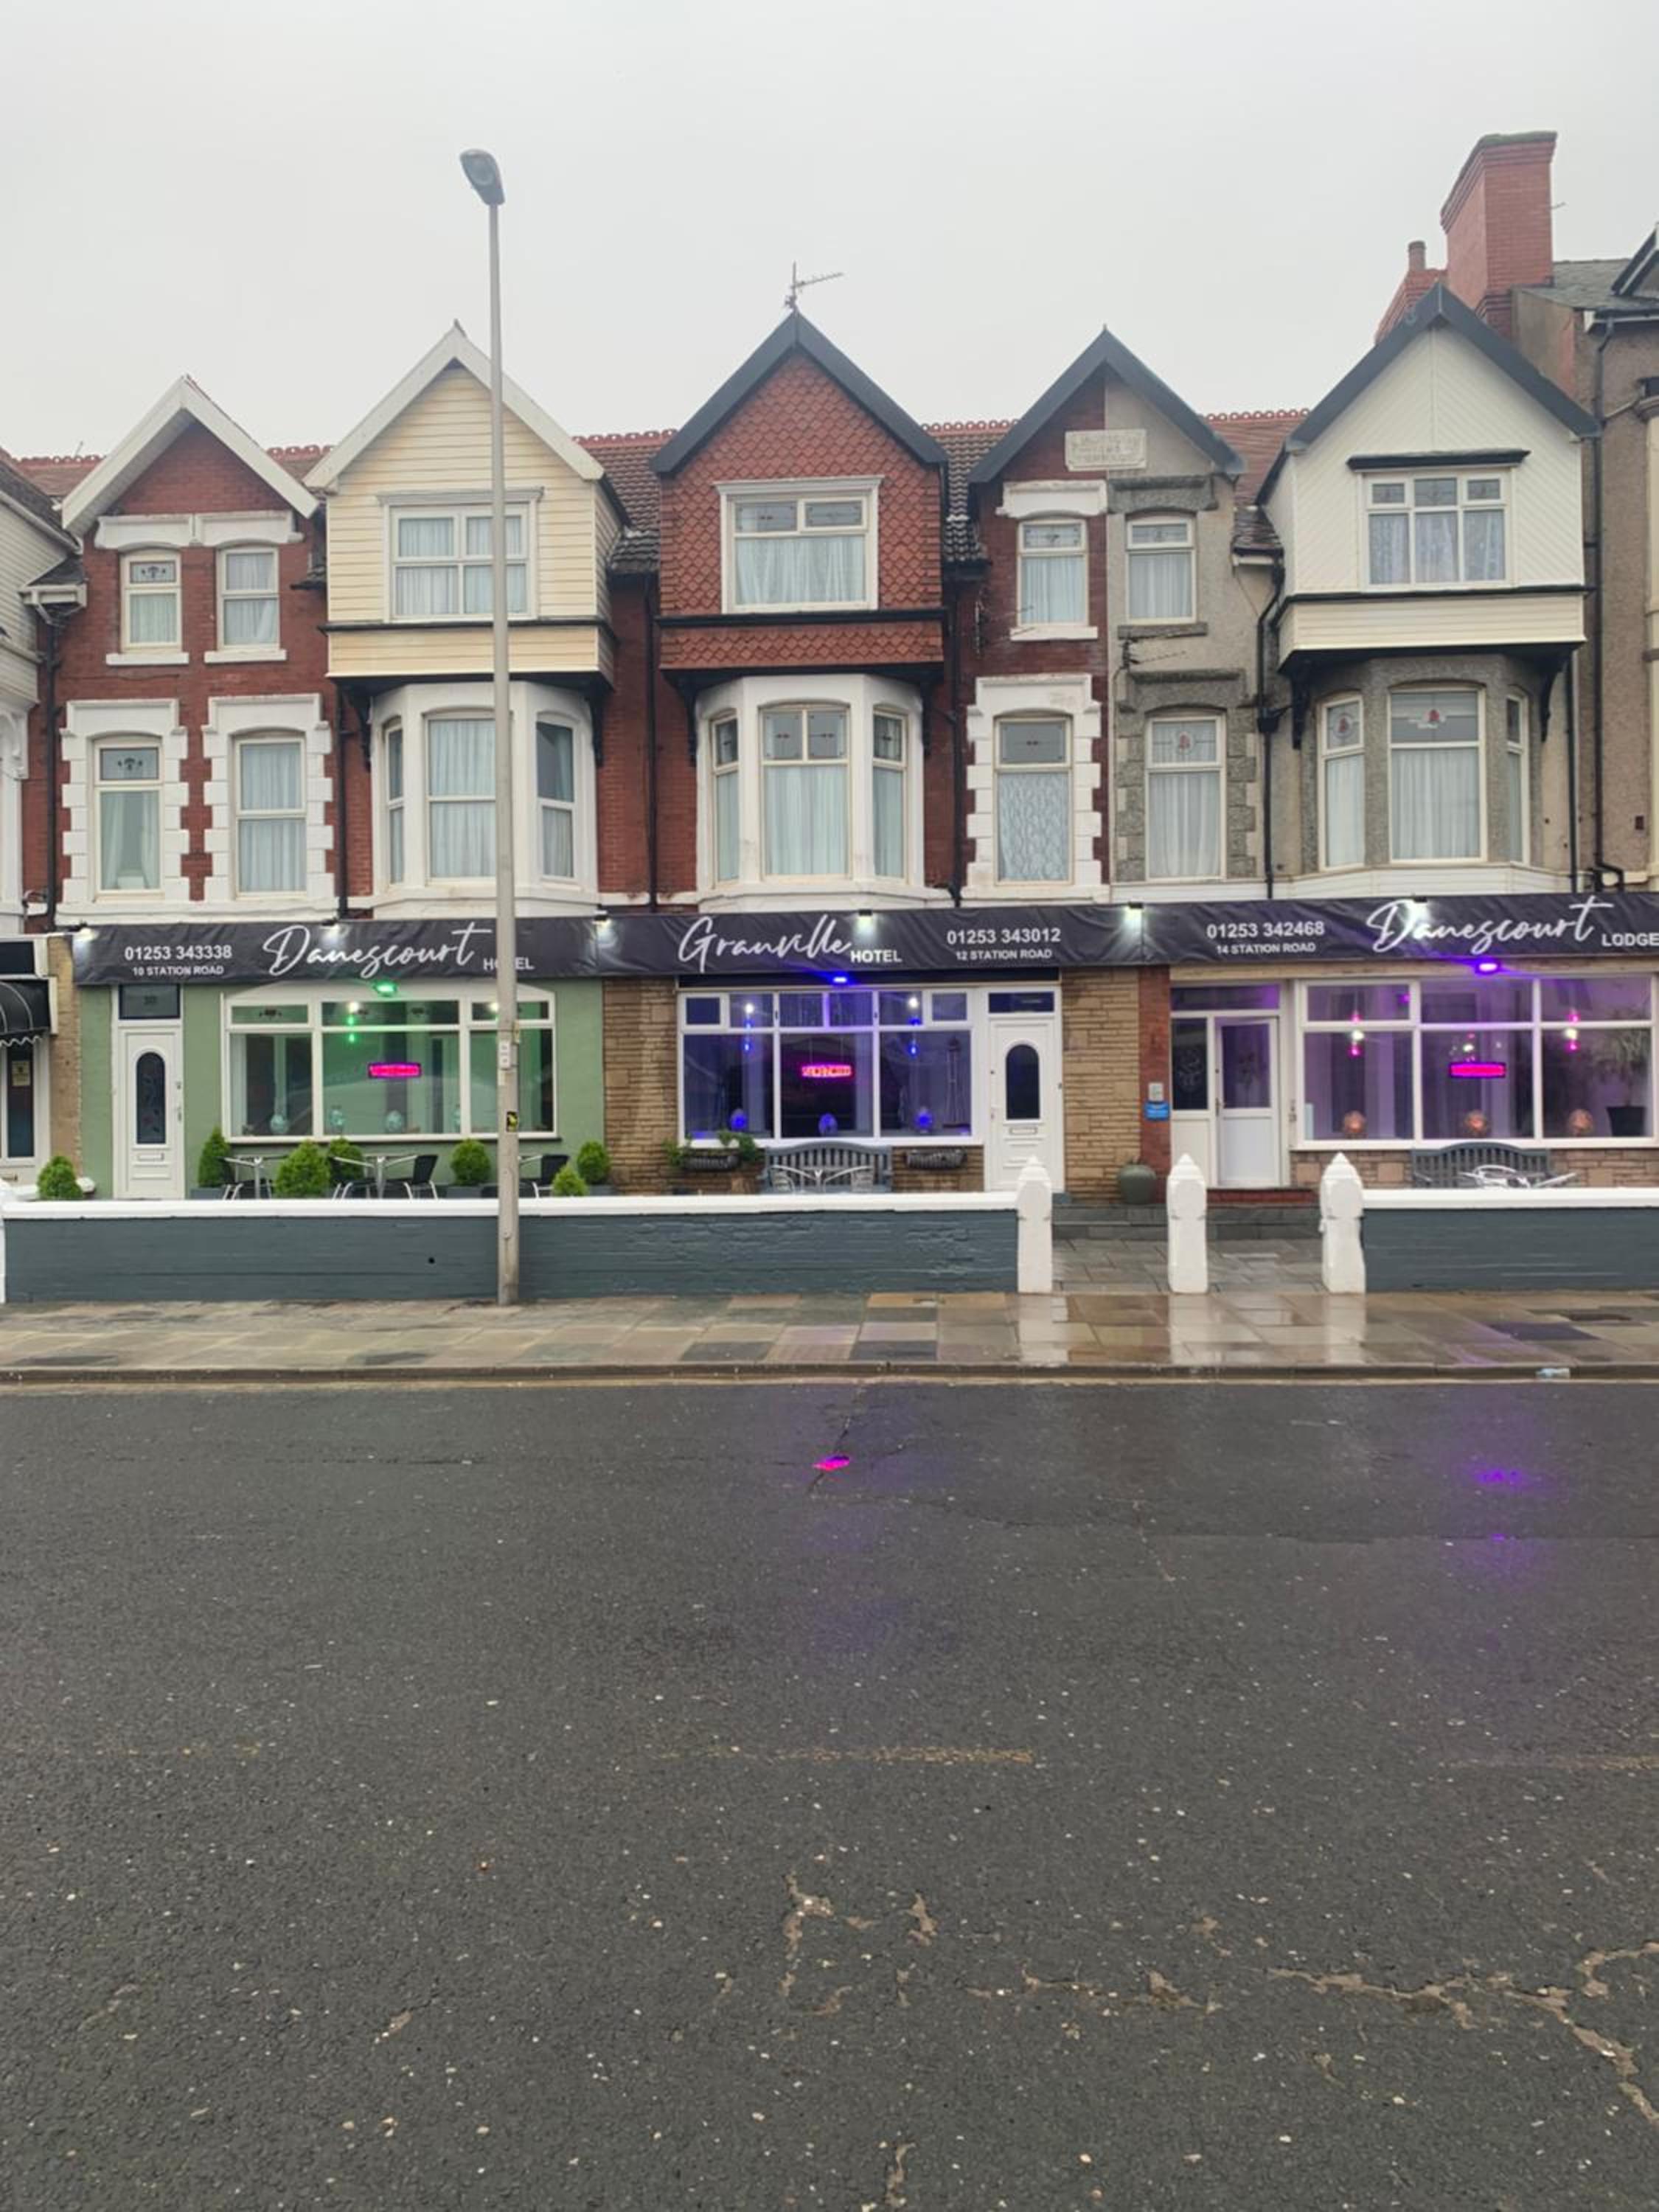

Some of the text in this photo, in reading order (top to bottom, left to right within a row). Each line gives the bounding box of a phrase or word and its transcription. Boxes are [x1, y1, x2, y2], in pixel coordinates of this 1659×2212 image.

[1206, 920, 1324, 939] 01253 342468
[1366, 895, 1659, 955] Danescourt LODGE
[678, 914, 902, 973] Granville HOTEL
[947, 928, 1061, 945] 01253 343012
[125, 945, 232, 960] 01253 343338
[262, 922, 535, 977] Danescourt HEL
[970, 949, 1018, 960] STATION
[1020, 948, 1052, 959] ROAD
[1217, 942, 1316, 955] 14 STATION ROAD
[147, 966, 191, 976] STATION
[193, 965, 224, 975] ROAD
